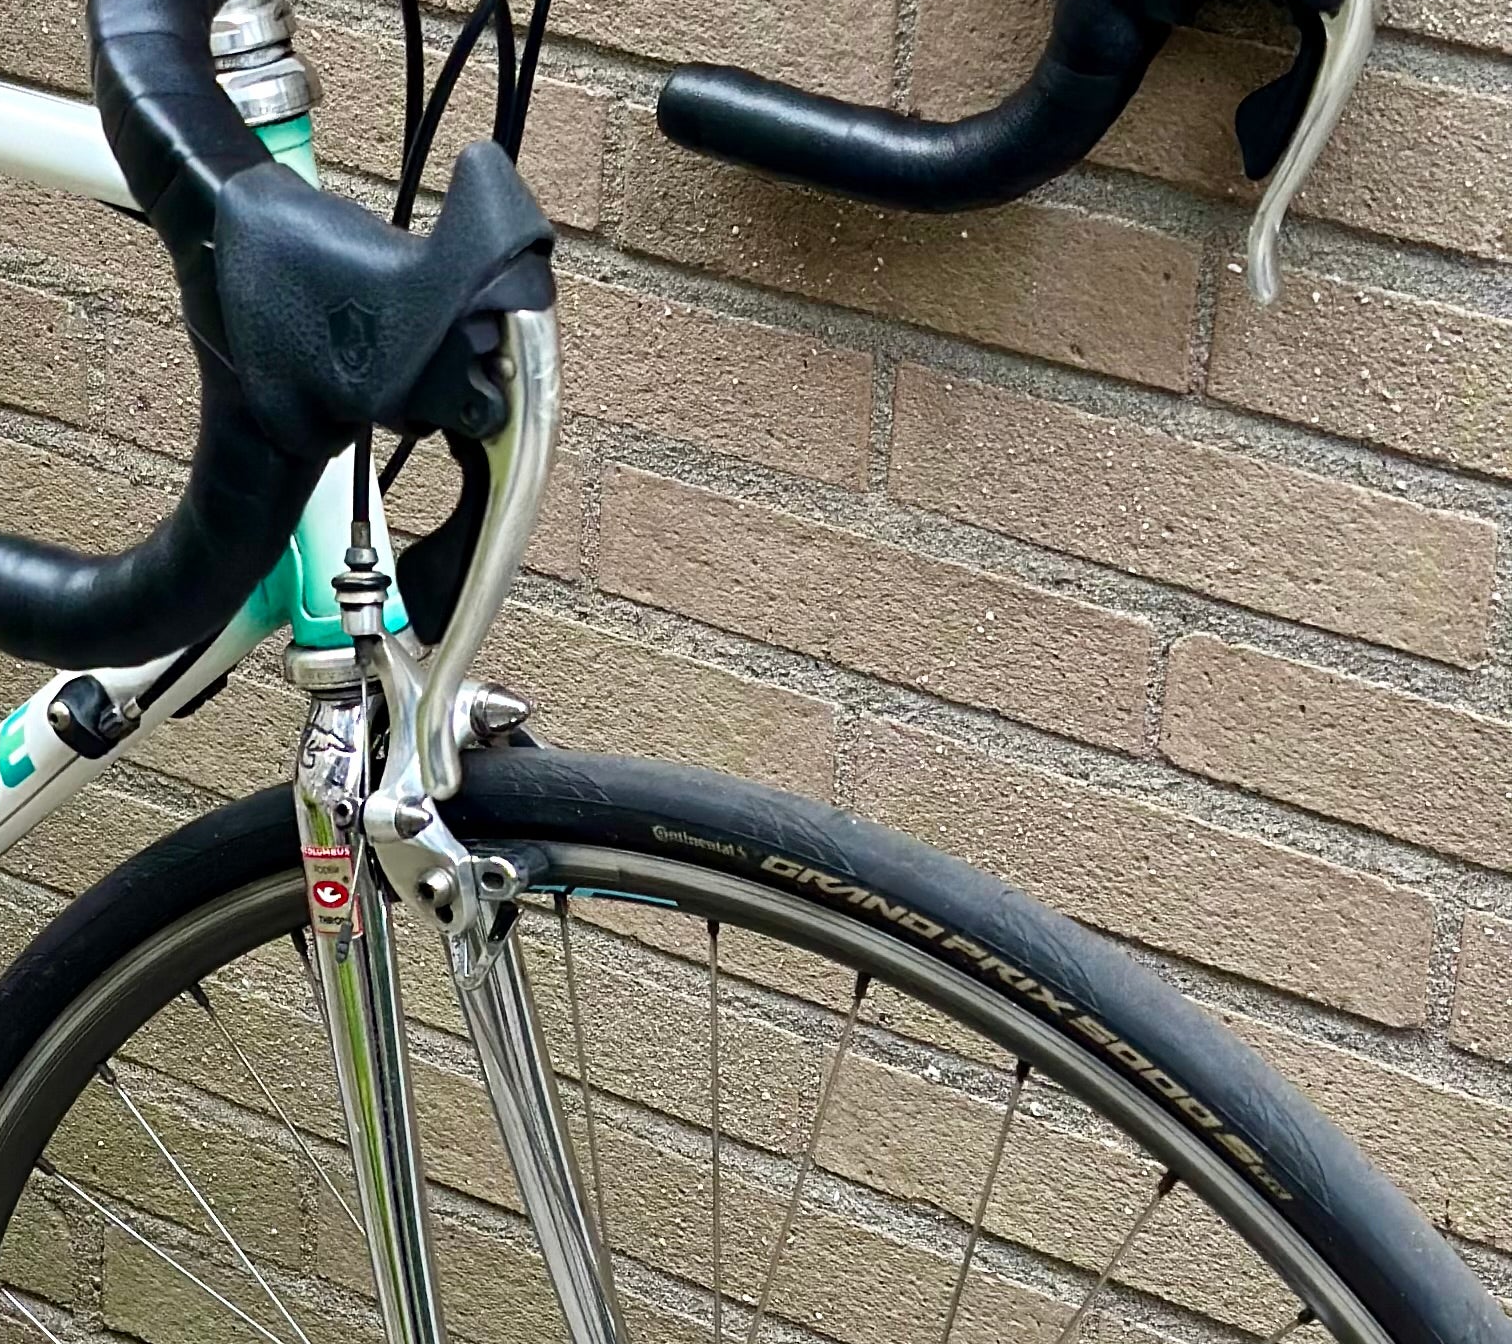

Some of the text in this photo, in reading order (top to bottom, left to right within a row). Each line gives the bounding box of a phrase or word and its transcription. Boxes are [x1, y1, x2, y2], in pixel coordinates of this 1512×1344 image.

[760, 855, 946, 939] GRAND
[940, 934, 1077, 1016] PRIX
[1068, 1014, 1224, 1129] 5000
